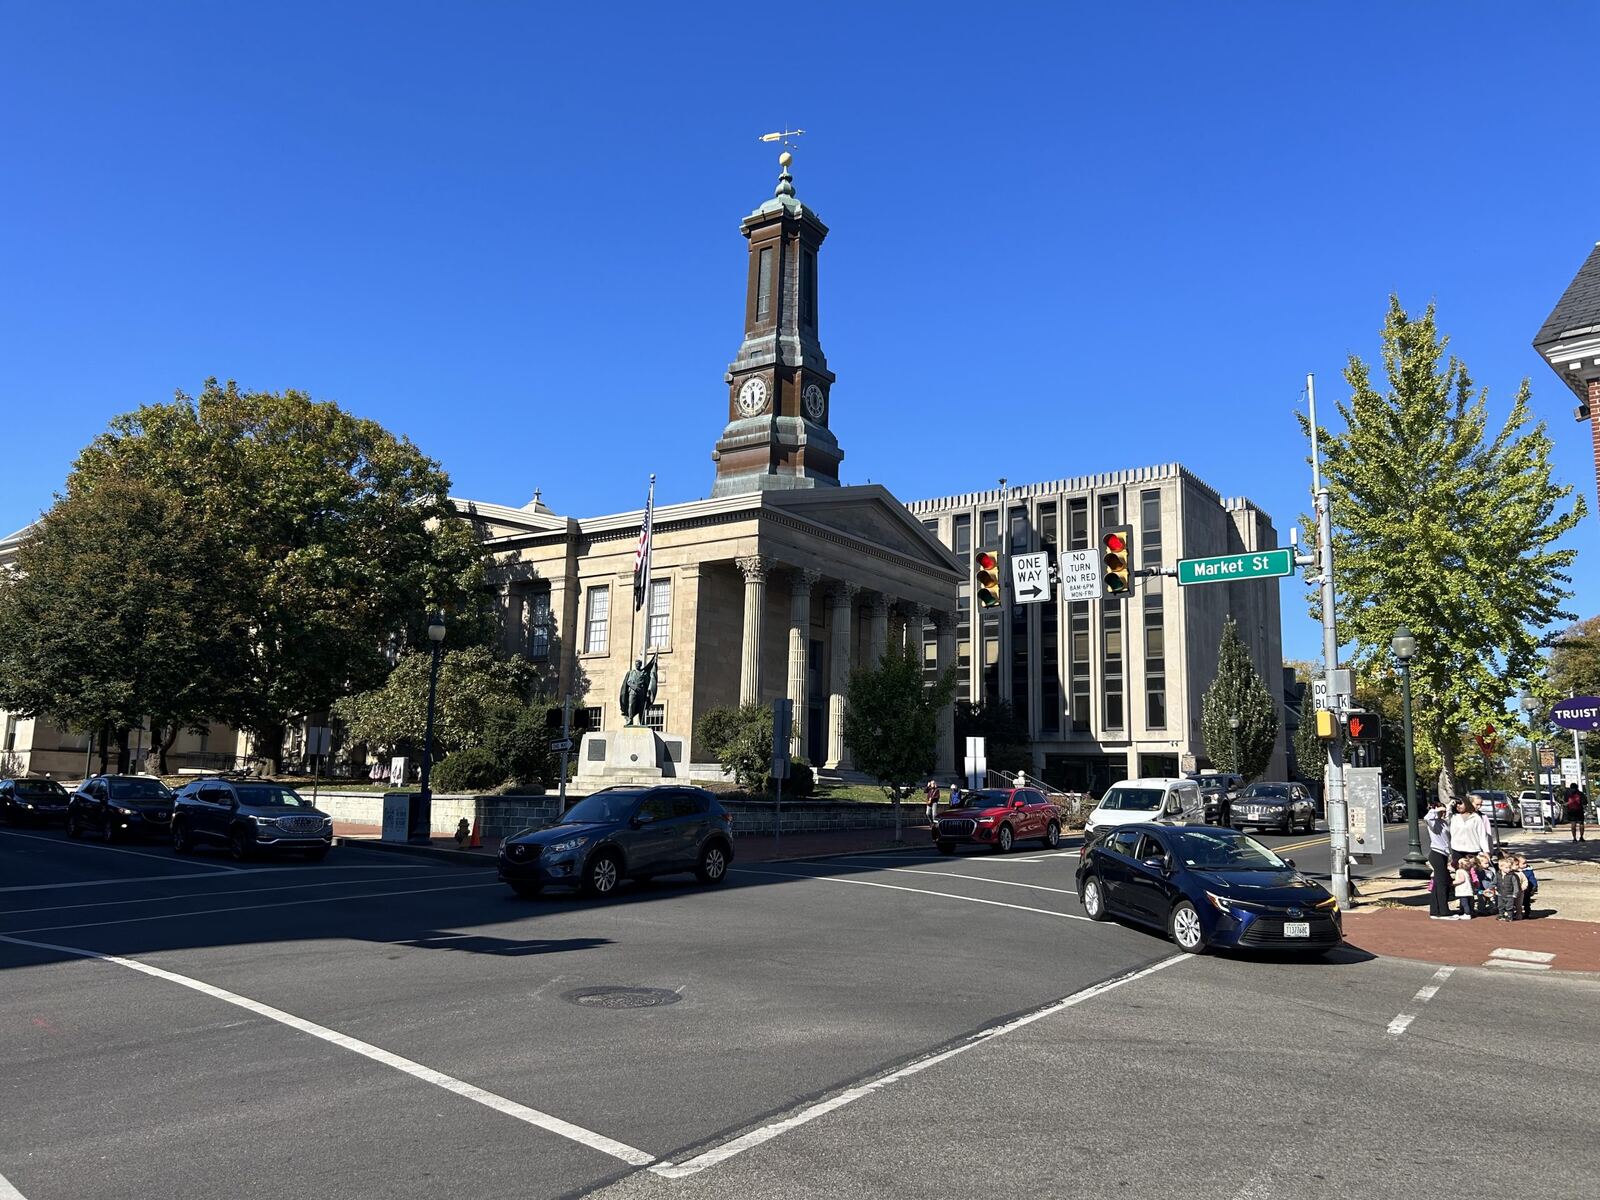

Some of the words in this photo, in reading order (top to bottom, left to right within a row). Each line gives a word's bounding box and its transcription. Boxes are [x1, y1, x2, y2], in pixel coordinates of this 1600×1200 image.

[1072, 553, 1086, 561] NO
[1018, 557, 1041, 570] ONE
[1070, 563, 1091, 572] TURN
[1194, 559, 1244, 577] Market
[1252, 556, 1269, 571] St
[1018, 570, 1042, 583] WAY
[1066, 575, 1077, 583] ON
[1081, 572, 1096, 582] RED
[1315, 684, 1327, 695] DO
[1554, 708, 1598, 720] TRUIST
